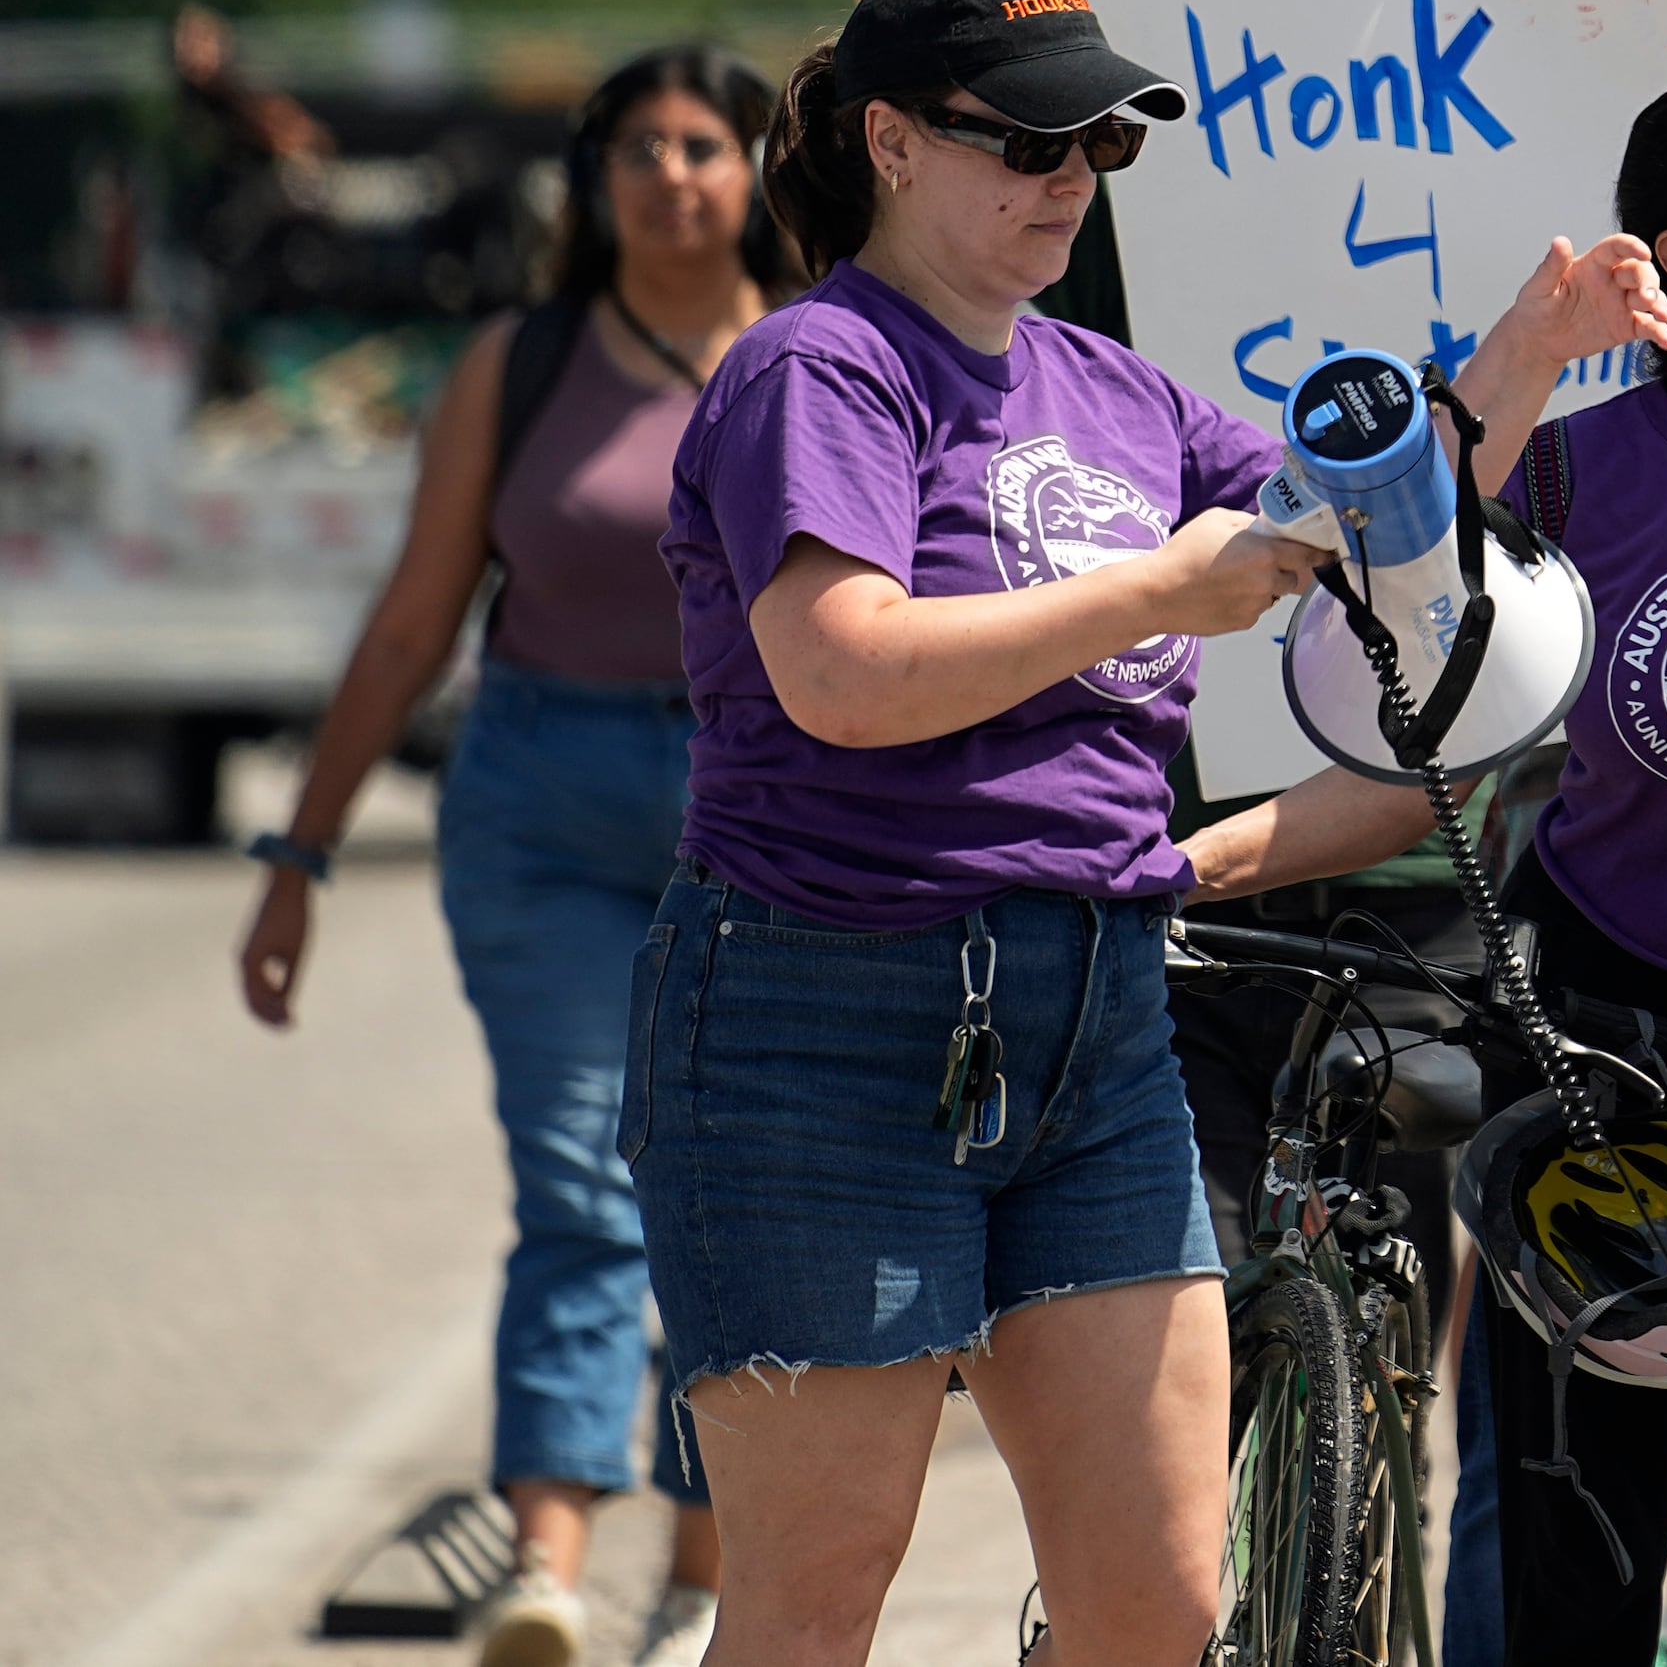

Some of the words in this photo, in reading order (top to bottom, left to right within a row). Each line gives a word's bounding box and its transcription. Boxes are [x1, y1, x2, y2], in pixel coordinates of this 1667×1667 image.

[1345, 179, 1443, 309] 4
[1340, 380, 1379, 432] PMP50
[1378, 370, 1409, 407] PYLE
[1273, 477, 1304, 513] PYLE
